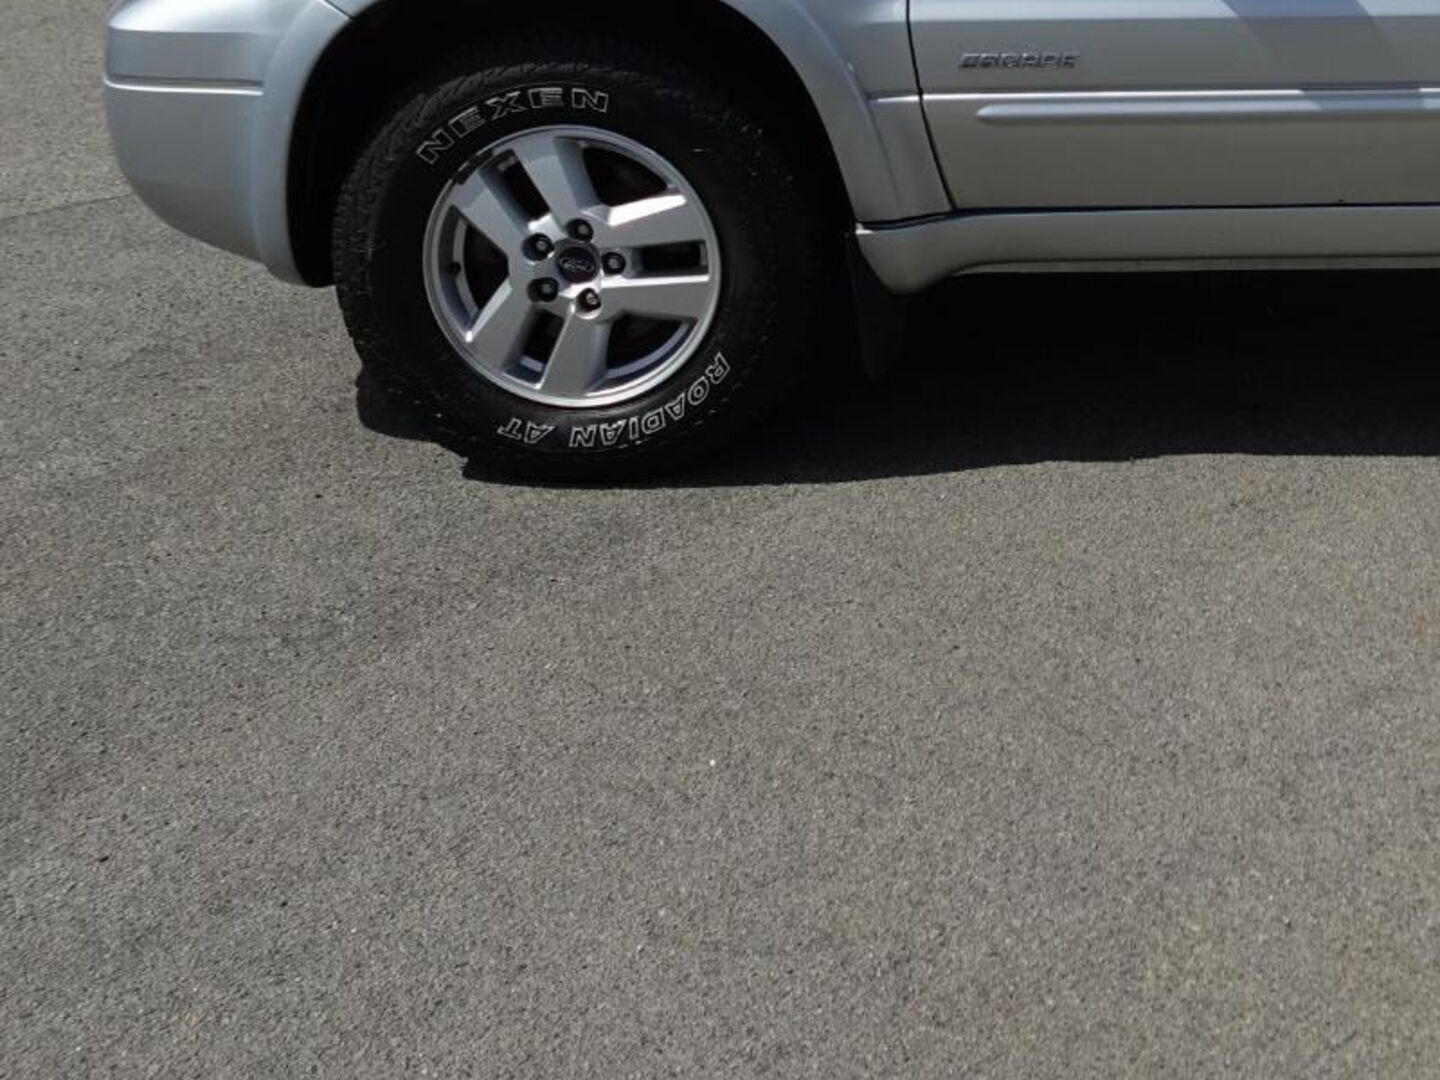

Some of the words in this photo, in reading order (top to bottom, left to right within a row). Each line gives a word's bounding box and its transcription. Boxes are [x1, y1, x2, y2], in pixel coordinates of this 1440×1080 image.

[959, 52, 1079, 69] ESCAPE
[417, 86, 610, 164] NEXEN
[568, 351, 732, 448] ROADIAN
[497, 417, 555, 444] AT
